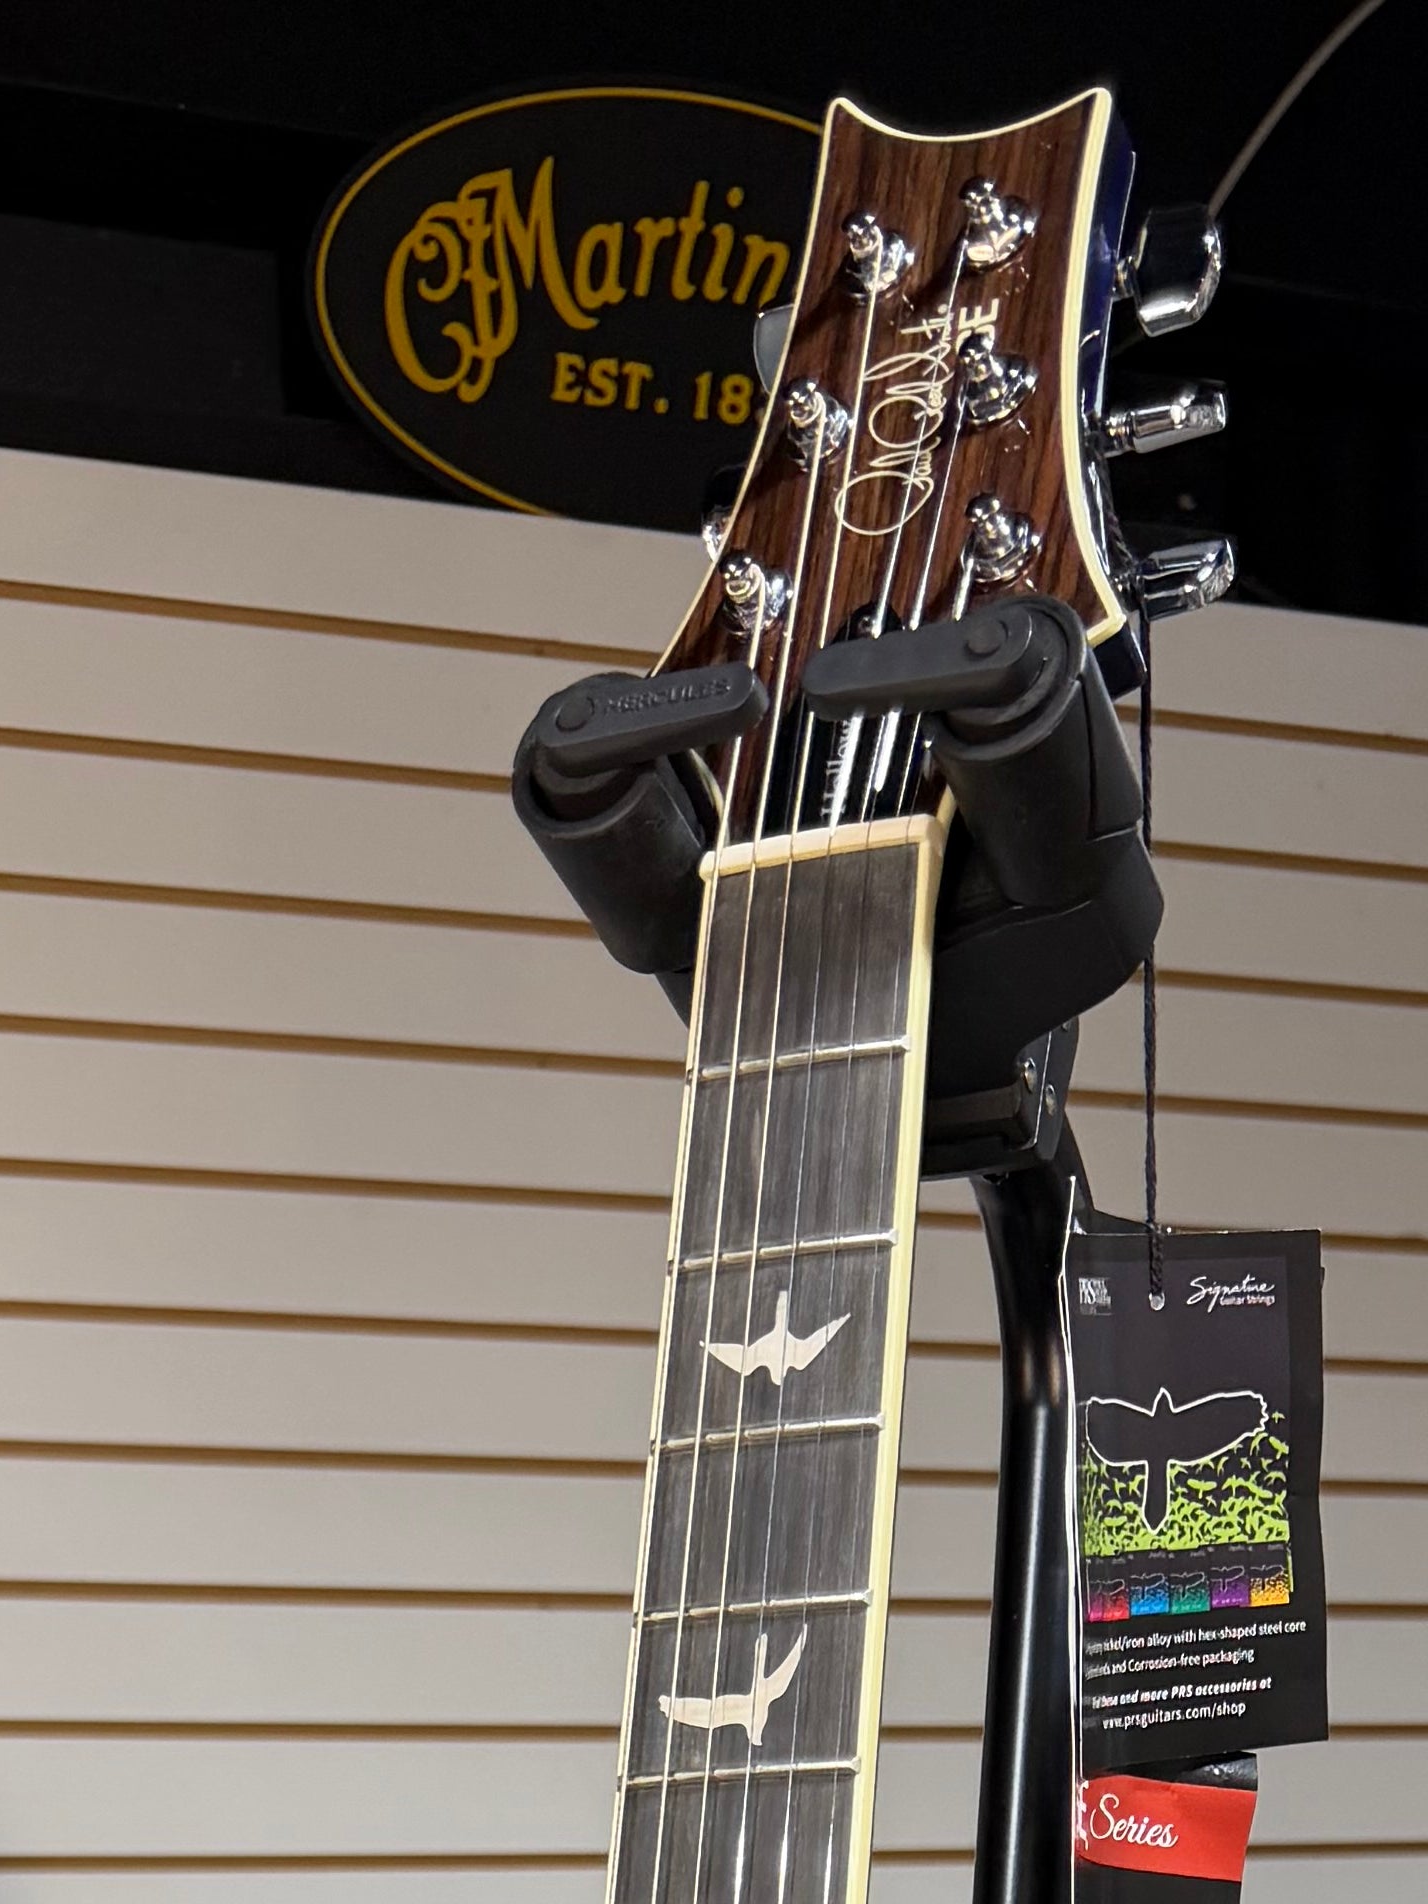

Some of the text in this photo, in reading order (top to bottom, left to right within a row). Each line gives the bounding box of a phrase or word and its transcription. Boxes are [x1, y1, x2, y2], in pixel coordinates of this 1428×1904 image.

[551, 351, 767, 426] EST. 18
[1186, 1274, 1275, 1313] Signature
[1258, 1620, 1283, 1636] steel
[1284, 1620, 1307, 1634] core
[1202, 1647, 1255, 1668] packaging
[1140, 1688, 1169, 1704] more
[1171, 1684, 1194, 1700] PRS
[1195, 1677, 1258, 1697] accessories
[1259, 1676, 1273, 1690] at
[1089, 1792, 1179, 1848] Series
